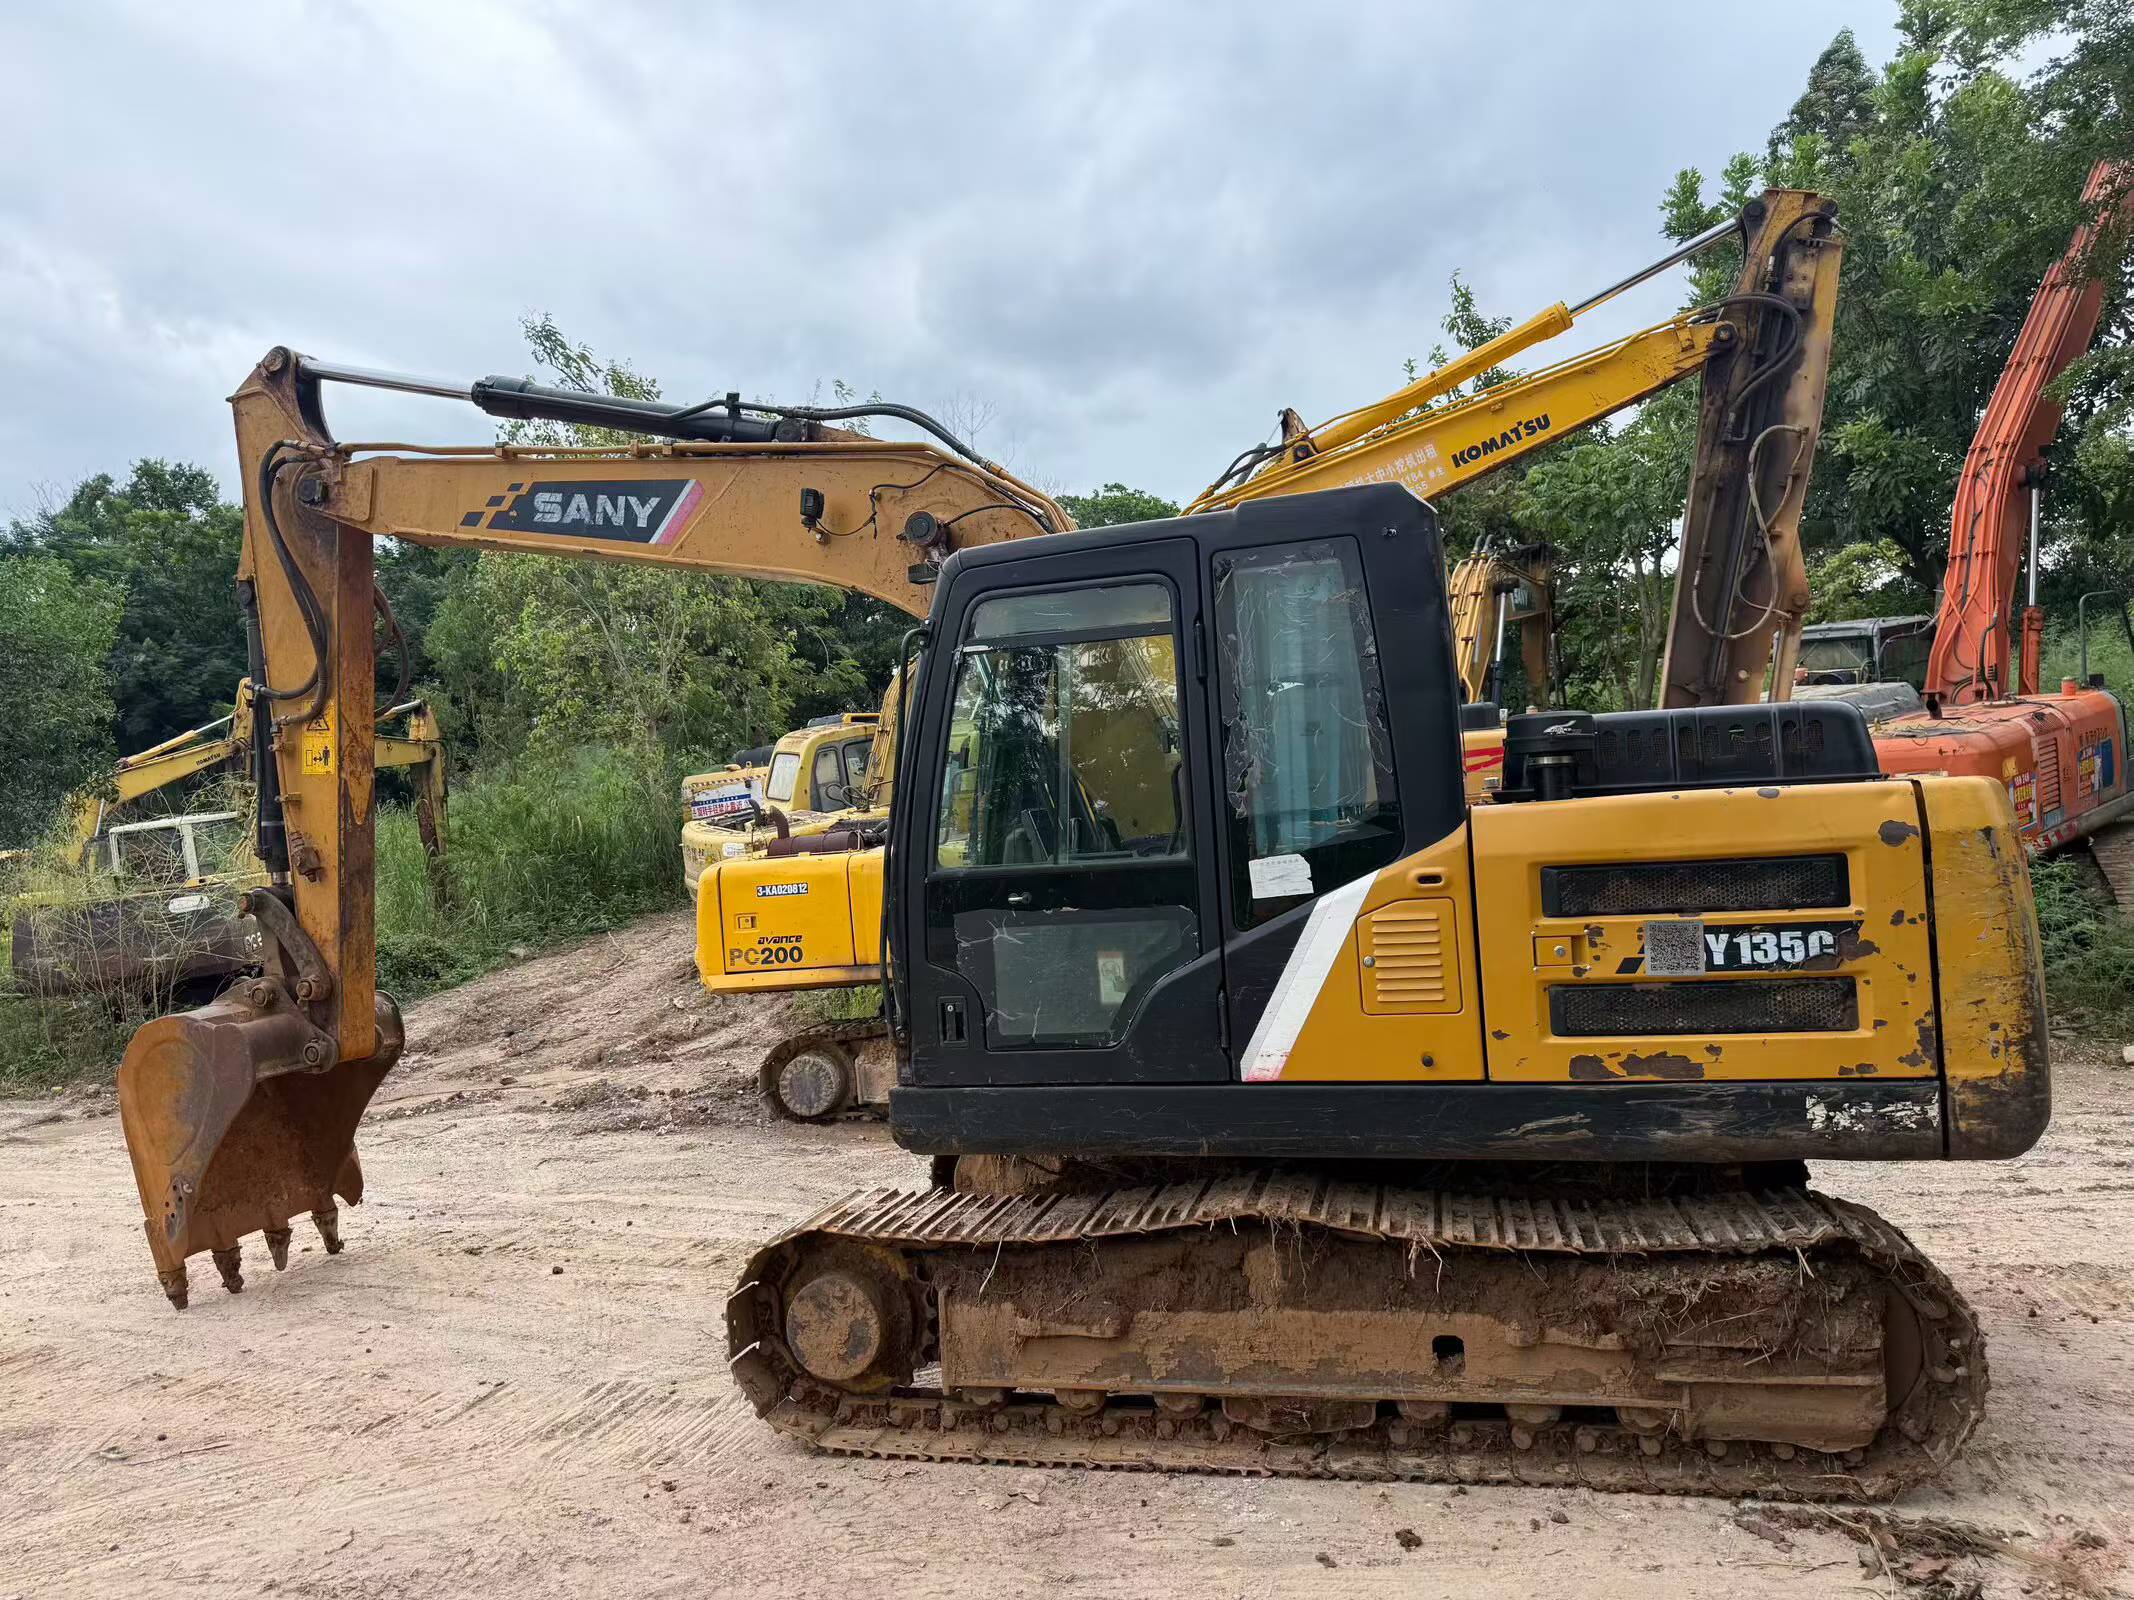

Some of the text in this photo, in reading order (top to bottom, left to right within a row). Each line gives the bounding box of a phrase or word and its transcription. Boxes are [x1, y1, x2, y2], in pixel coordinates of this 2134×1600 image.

[1451, 413, 1551, 468] KOMATSU
[533, 492, 662, 528] SANY
[195, 753, 221, 766] KOMATSU
[757, 883, 808, 896] 3-KA020812
[757, 934, 803, 945] avance
[1703, 930, 1837, 966] Y135C
[729, 946, 803, 967] PC200
